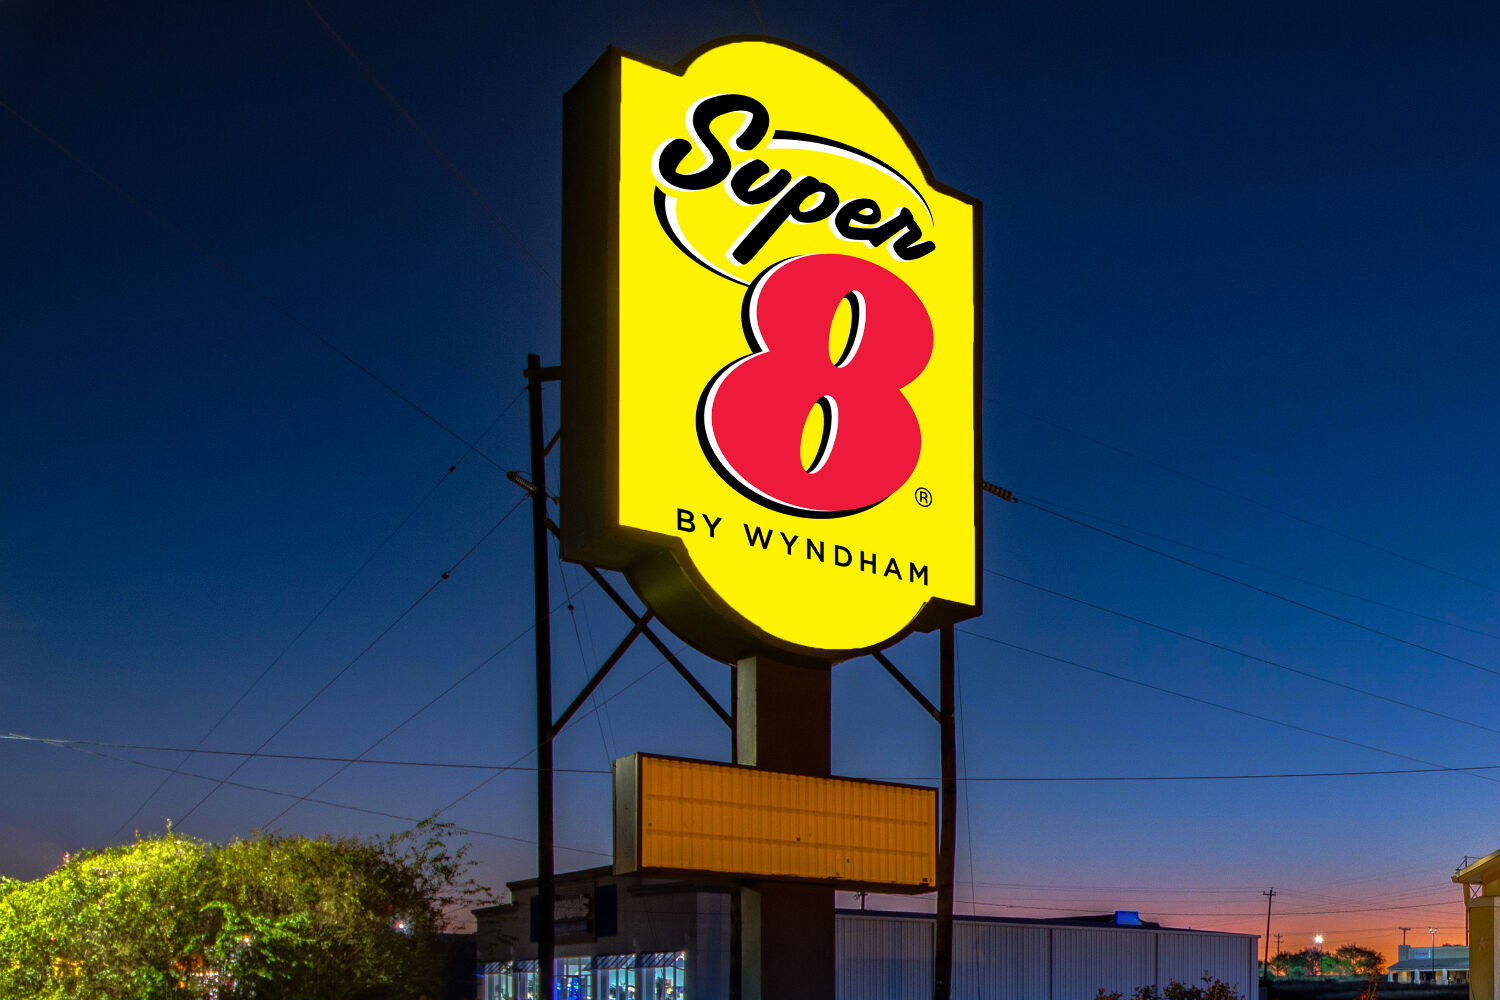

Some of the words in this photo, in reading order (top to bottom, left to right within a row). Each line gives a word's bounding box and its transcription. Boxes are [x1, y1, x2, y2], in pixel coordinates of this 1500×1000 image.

[652, 94, 936, 266] Super
[696, 253, 934, 519] 8
[677, 508, 722, 538] BY
[743, 523, 929, 586] WYNDHAM
